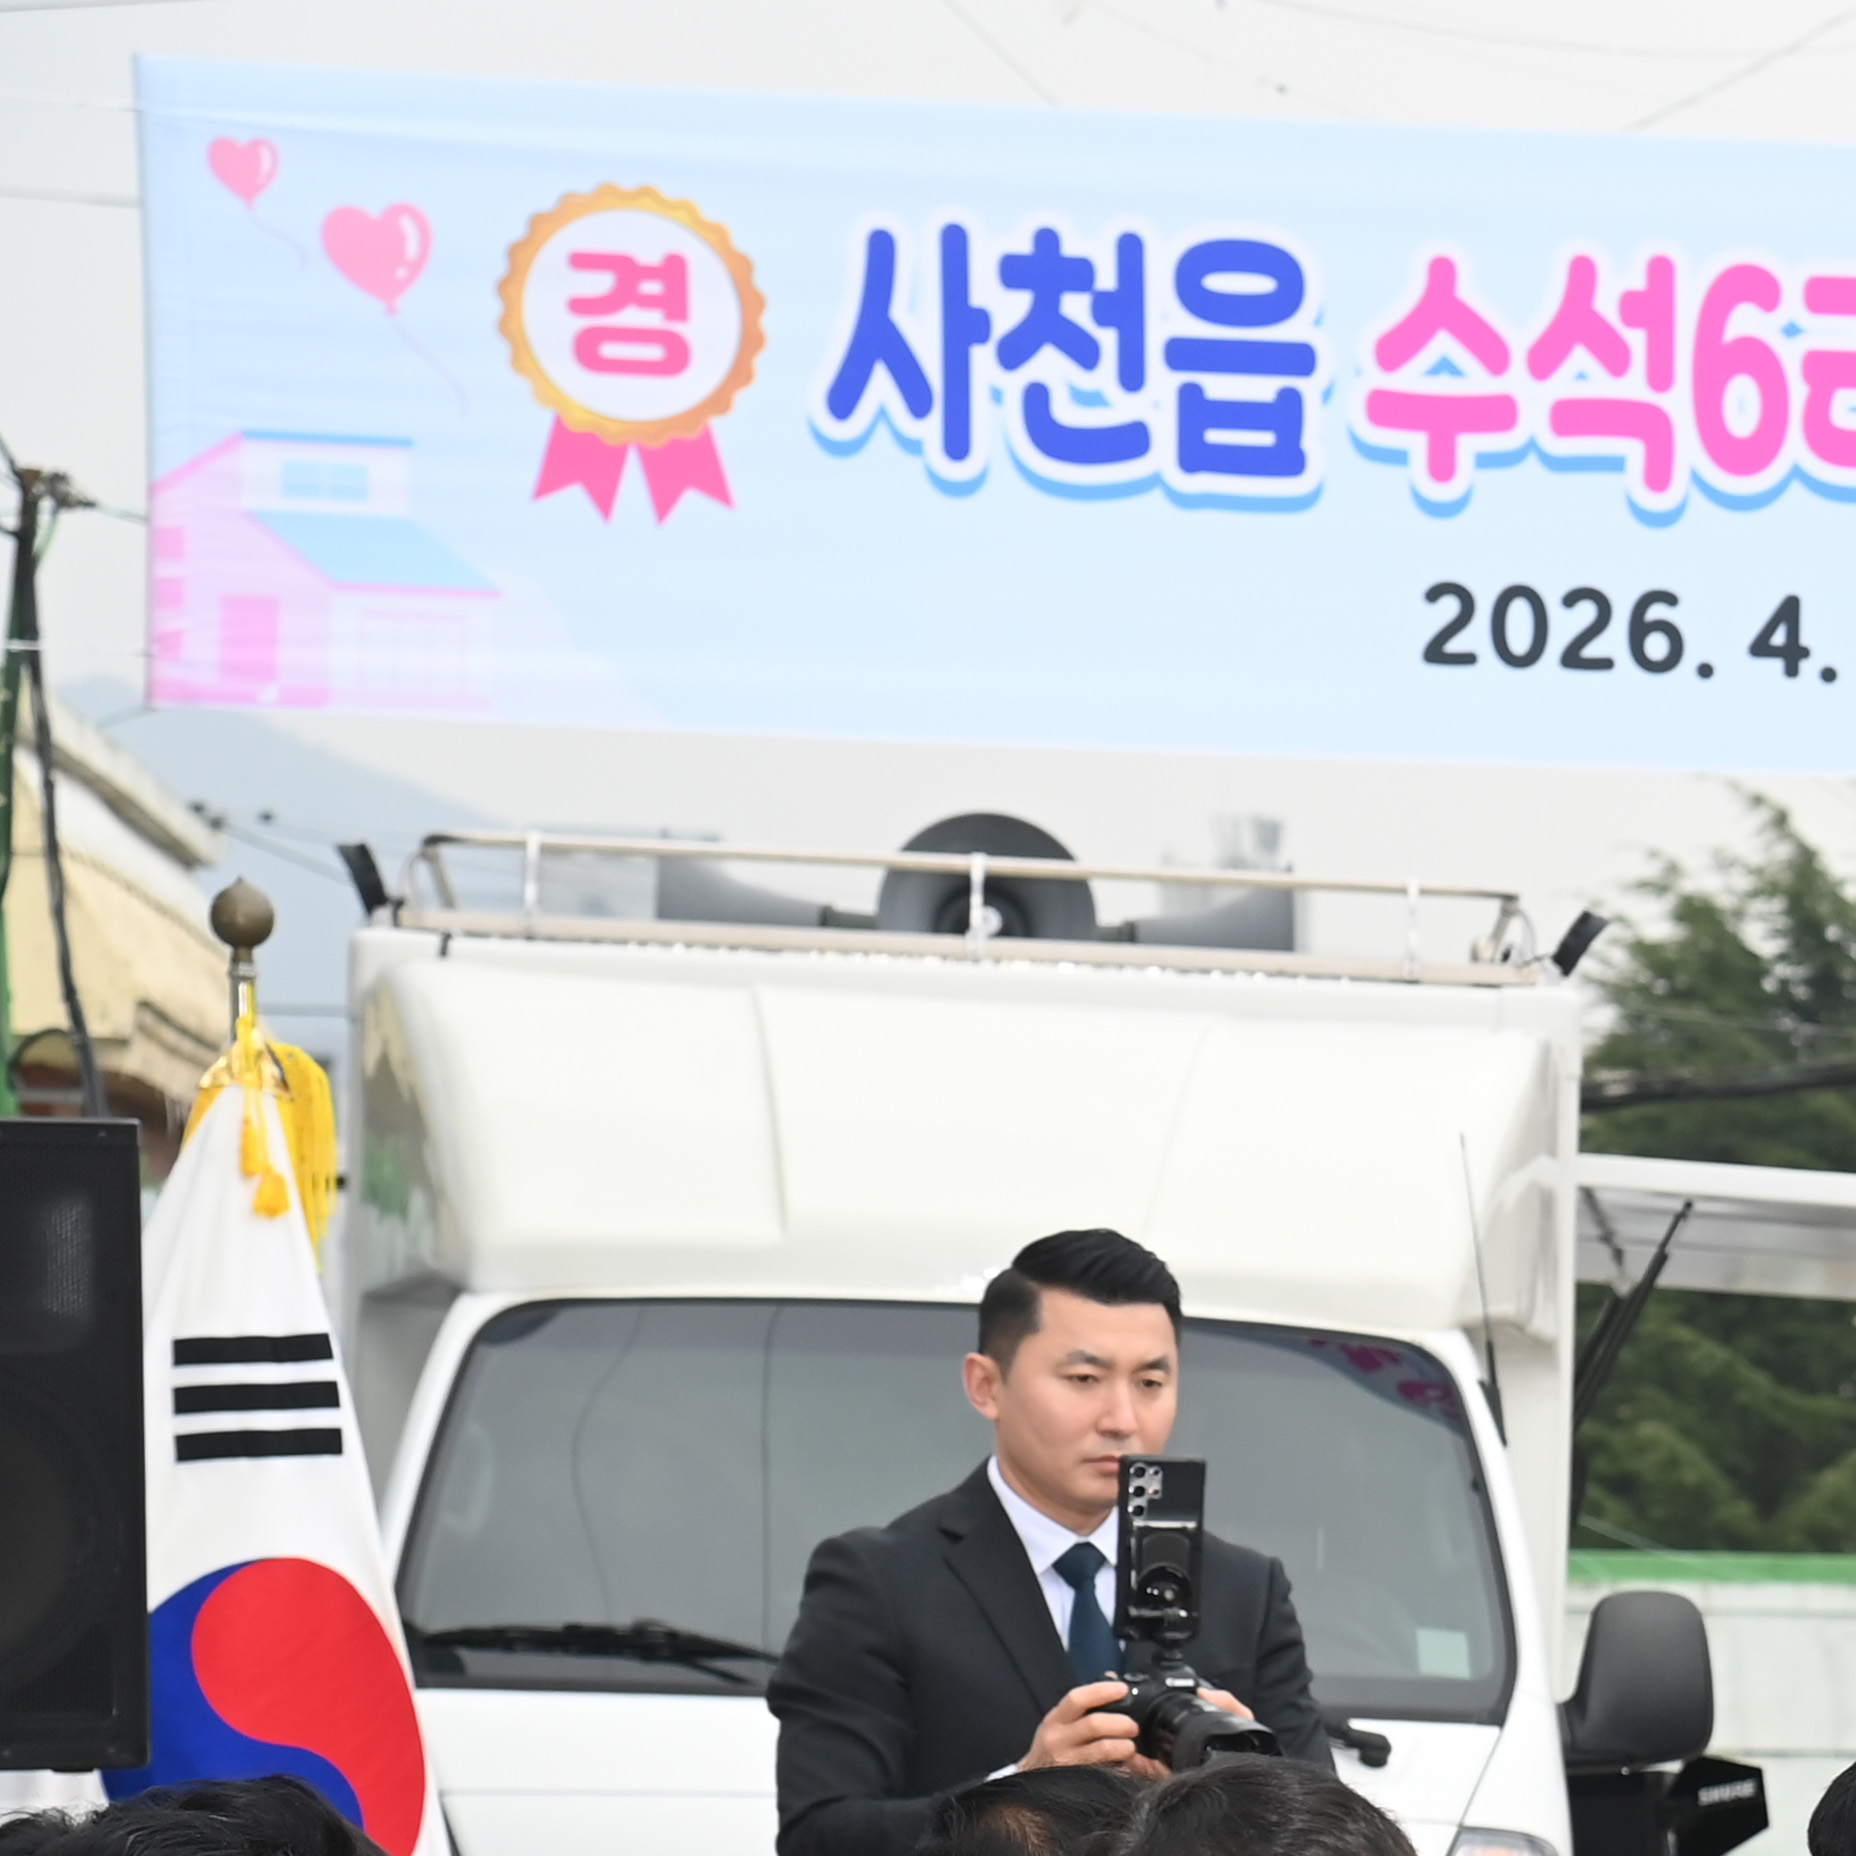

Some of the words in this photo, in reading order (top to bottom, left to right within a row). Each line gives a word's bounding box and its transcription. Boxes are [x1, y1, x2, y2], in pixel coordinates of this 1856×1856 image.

[567, 251, 692, 378] 경
[827, 222, 1318, 478] 사천읍
[1422, 581, 1715, 680] 2026.
[1748, 594, 1838, 684] 4.
